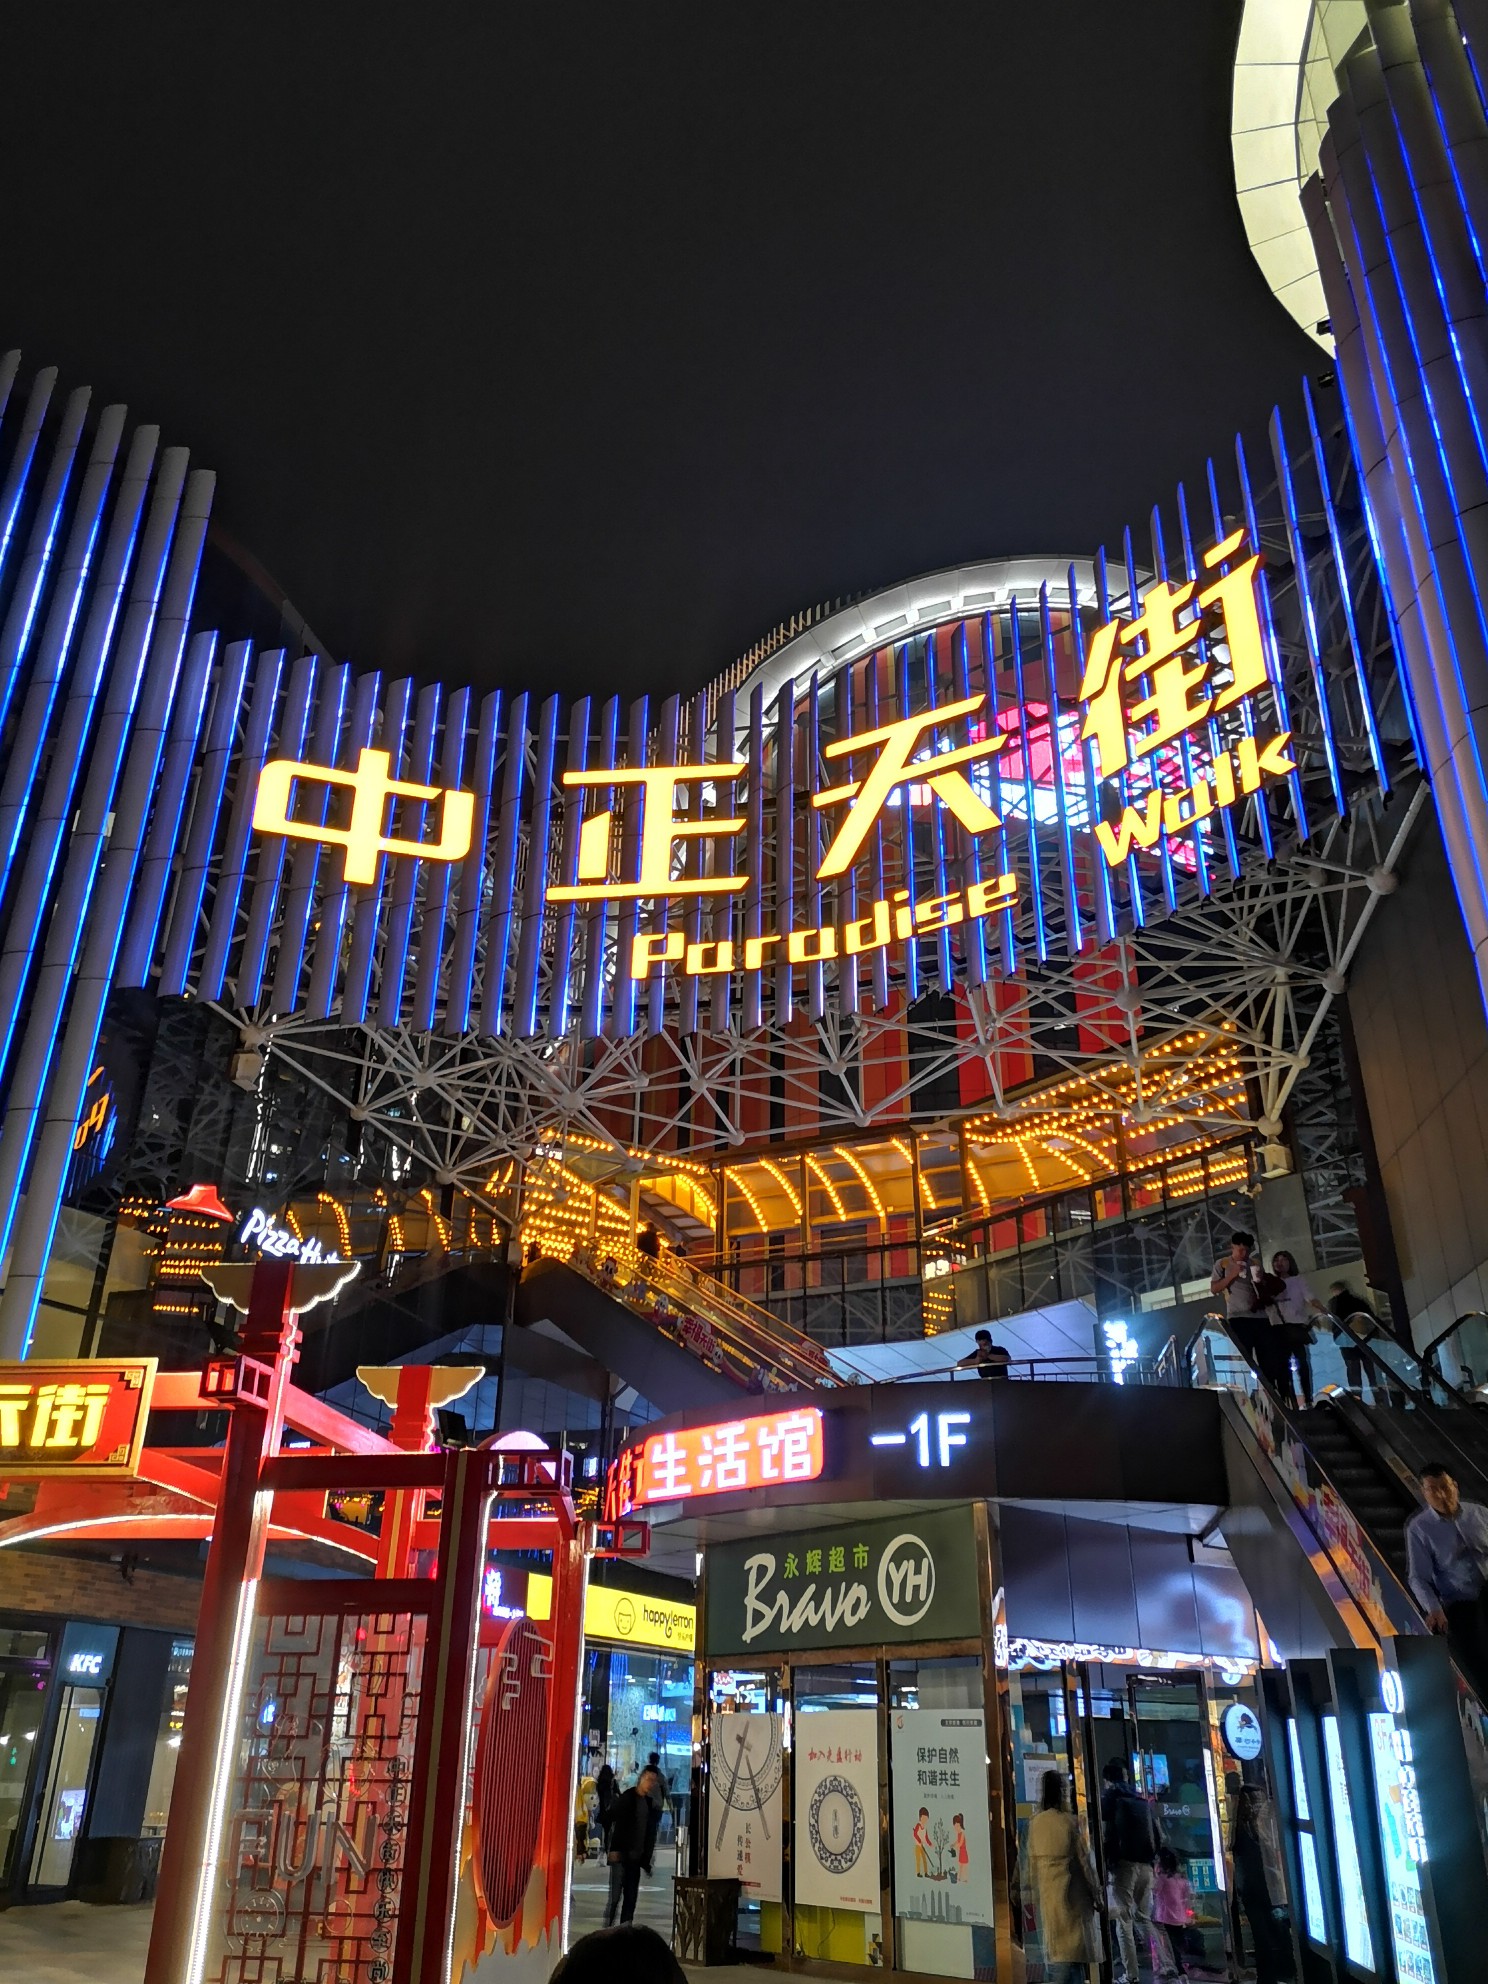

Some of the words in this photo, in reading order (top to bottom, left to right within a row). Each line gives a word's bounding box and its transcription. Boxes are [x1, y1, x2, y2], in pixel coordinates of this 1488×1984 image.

[251, 528, 1261, 902] 中正天街
[630, 872, 1018, 980] Paradise
[240, 1207, 300, 1257] Pizza
[783, 1543, 870, 1580] 永辉超市
[741, 1552, 872, 1644] Bravo
[70, 1654, 102, 1673] KFC
[916, 1747, 960, 1764] 保护自然
[916, 1769, 961, 1787] 和谐共生
